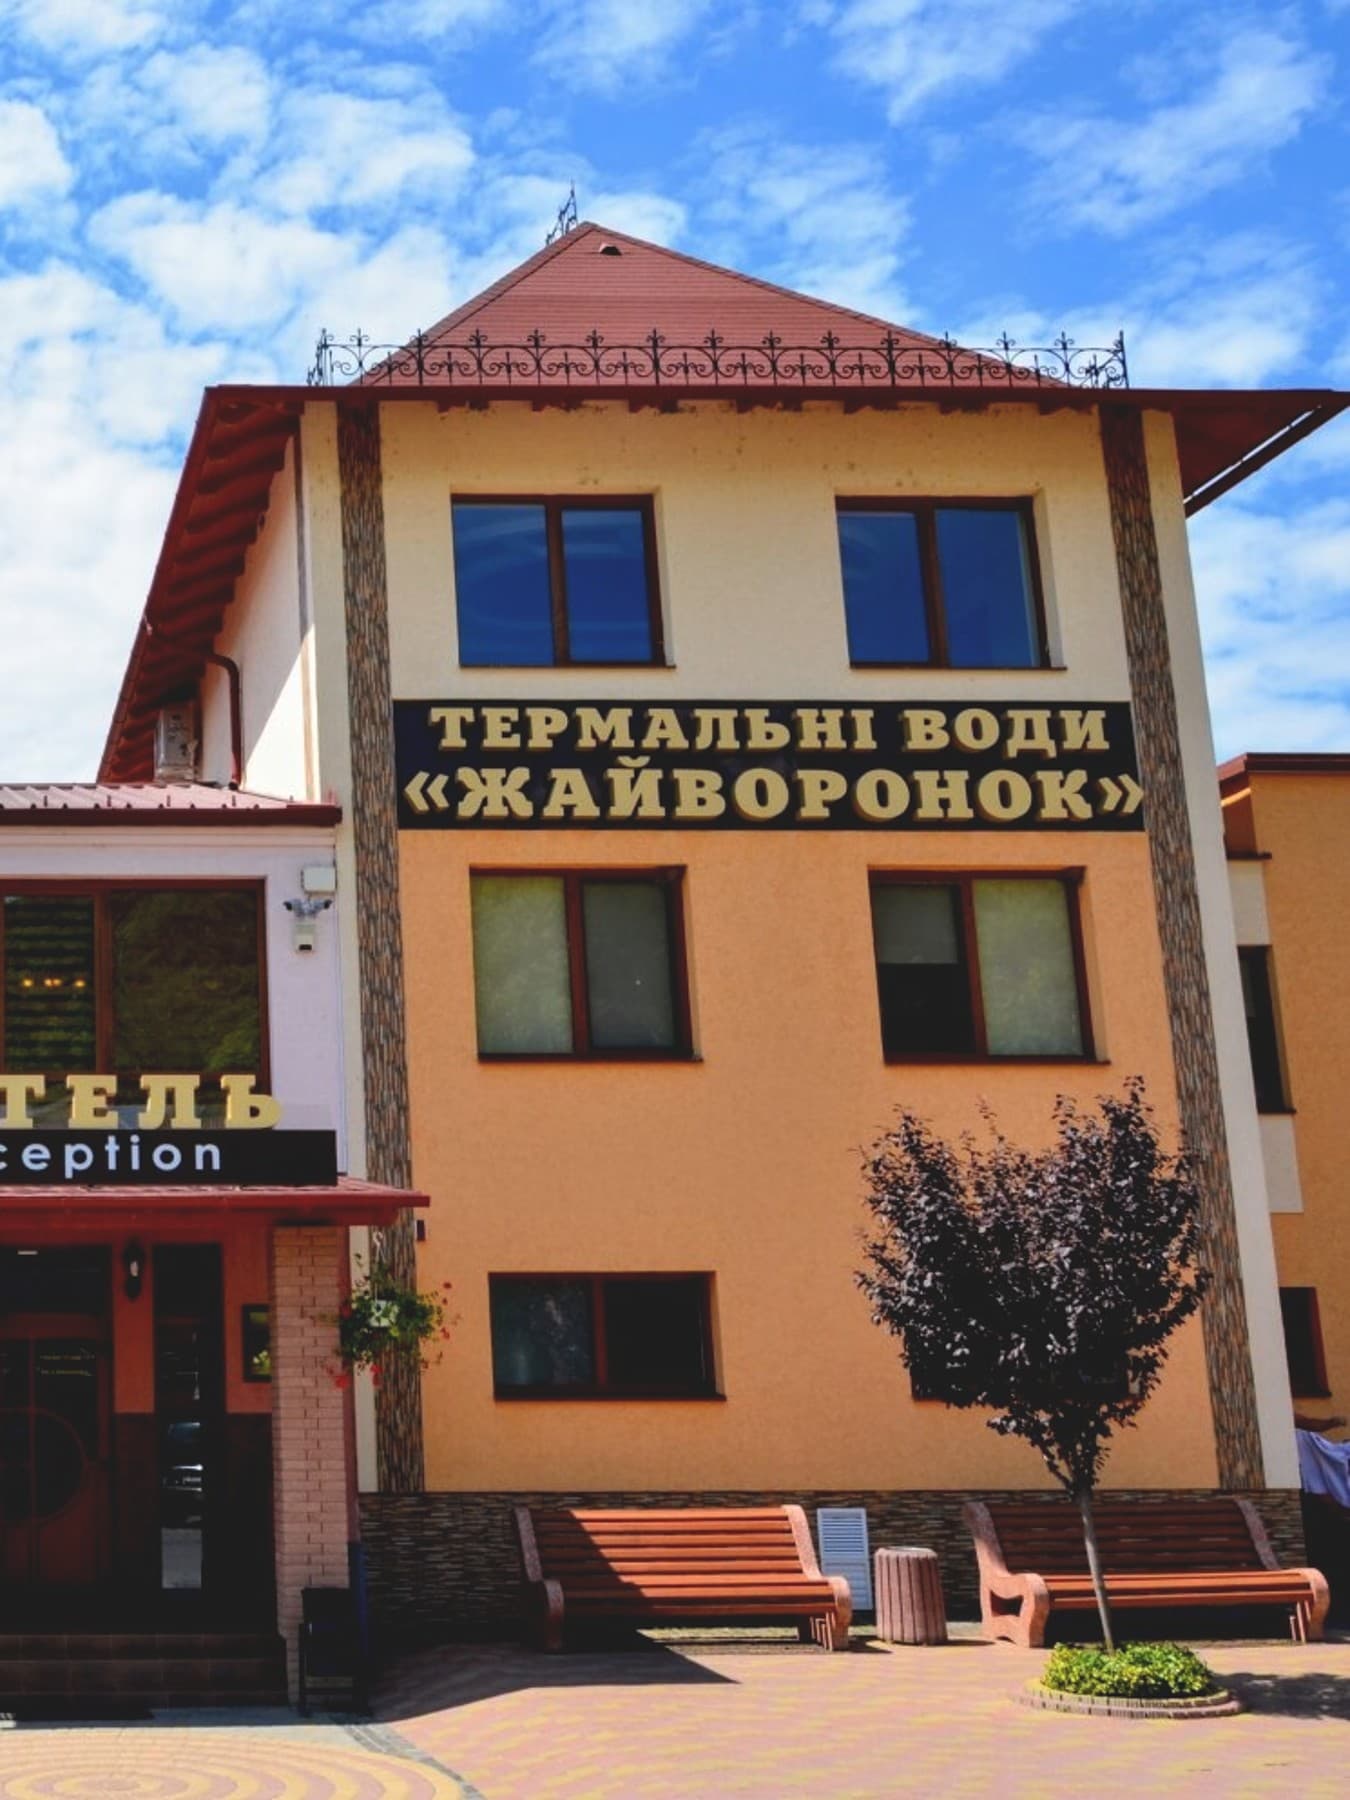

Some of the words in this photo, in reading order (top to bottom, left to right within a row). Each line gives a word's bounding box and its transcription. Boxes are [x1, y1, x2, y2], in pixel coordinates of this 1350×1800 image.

[428, 706, 876, 752] ТЕРМАЛЬНІ
[902, 706, 1111, 760] ВОДИ
[403, 754, 1146, 823] «ЖАЙВОРОНОК»
[0, 1073, 282, 1130] ТЕЛЬ
